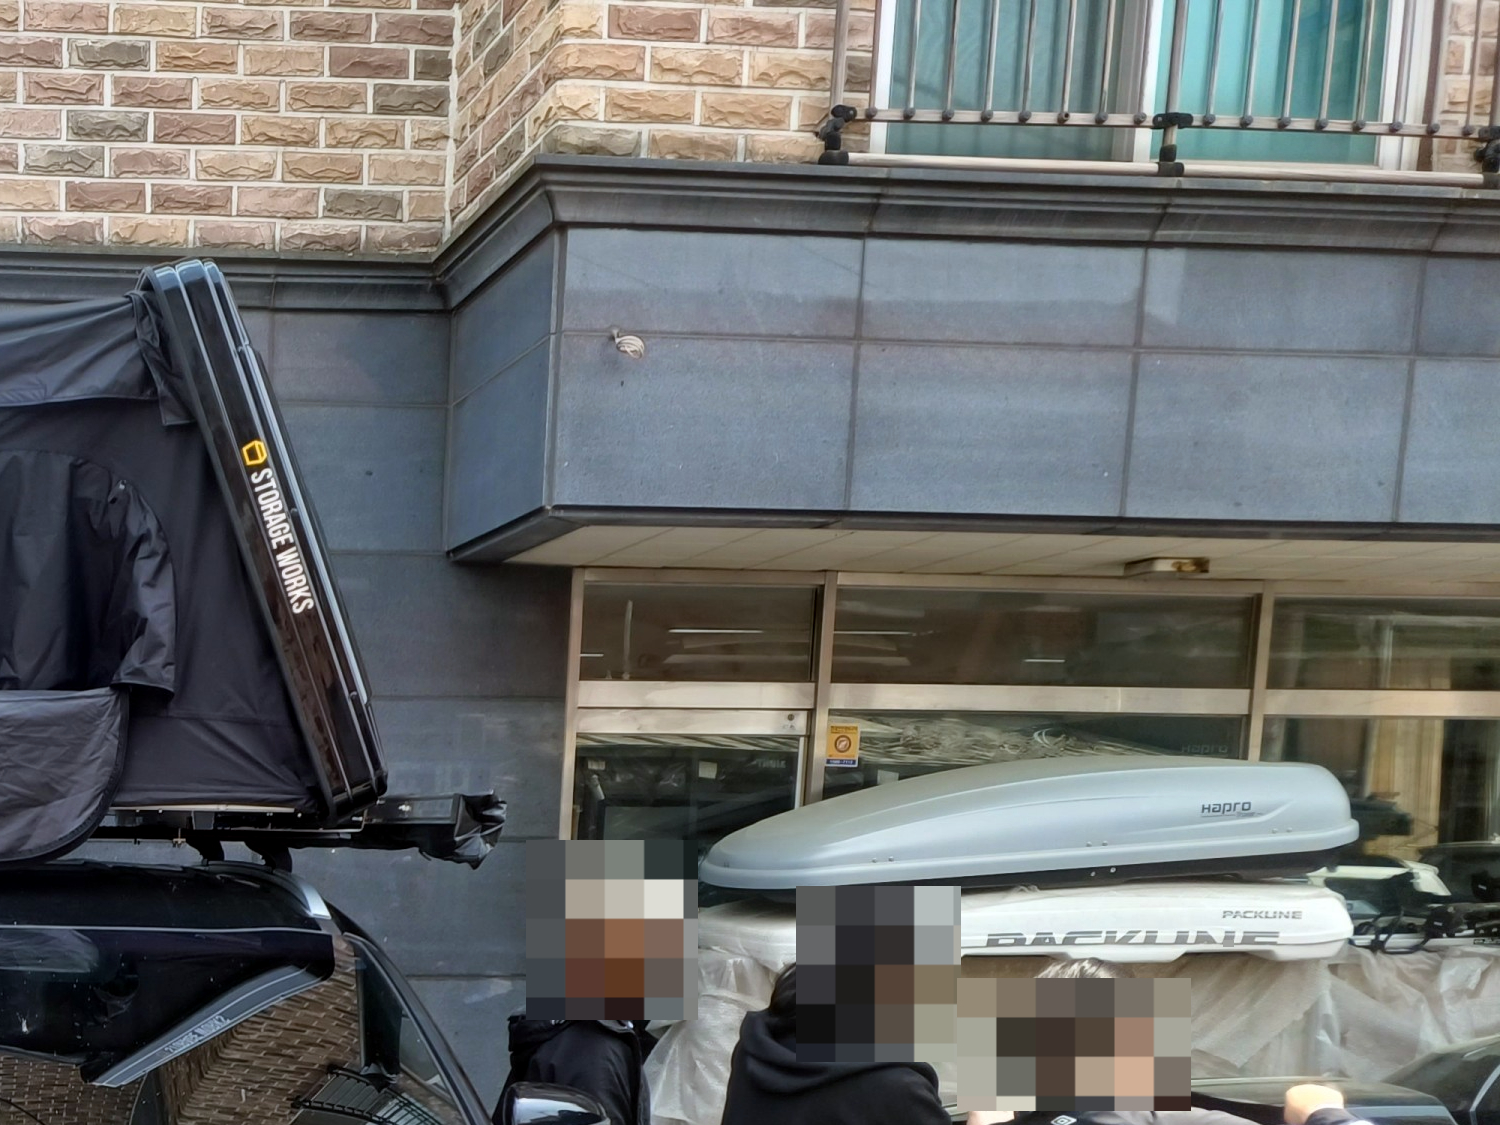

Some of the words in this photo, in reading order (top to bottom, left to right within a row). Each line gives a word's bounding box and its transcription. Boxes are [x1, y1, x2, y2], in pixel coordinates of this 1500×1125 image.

[250, 467, 295, 550] STORAGE
[275, 545, 315, 615] WORKS
[1201, 801, 1252, 815] Hapro
[1222, 910, 1303, 920] PACKLINE
